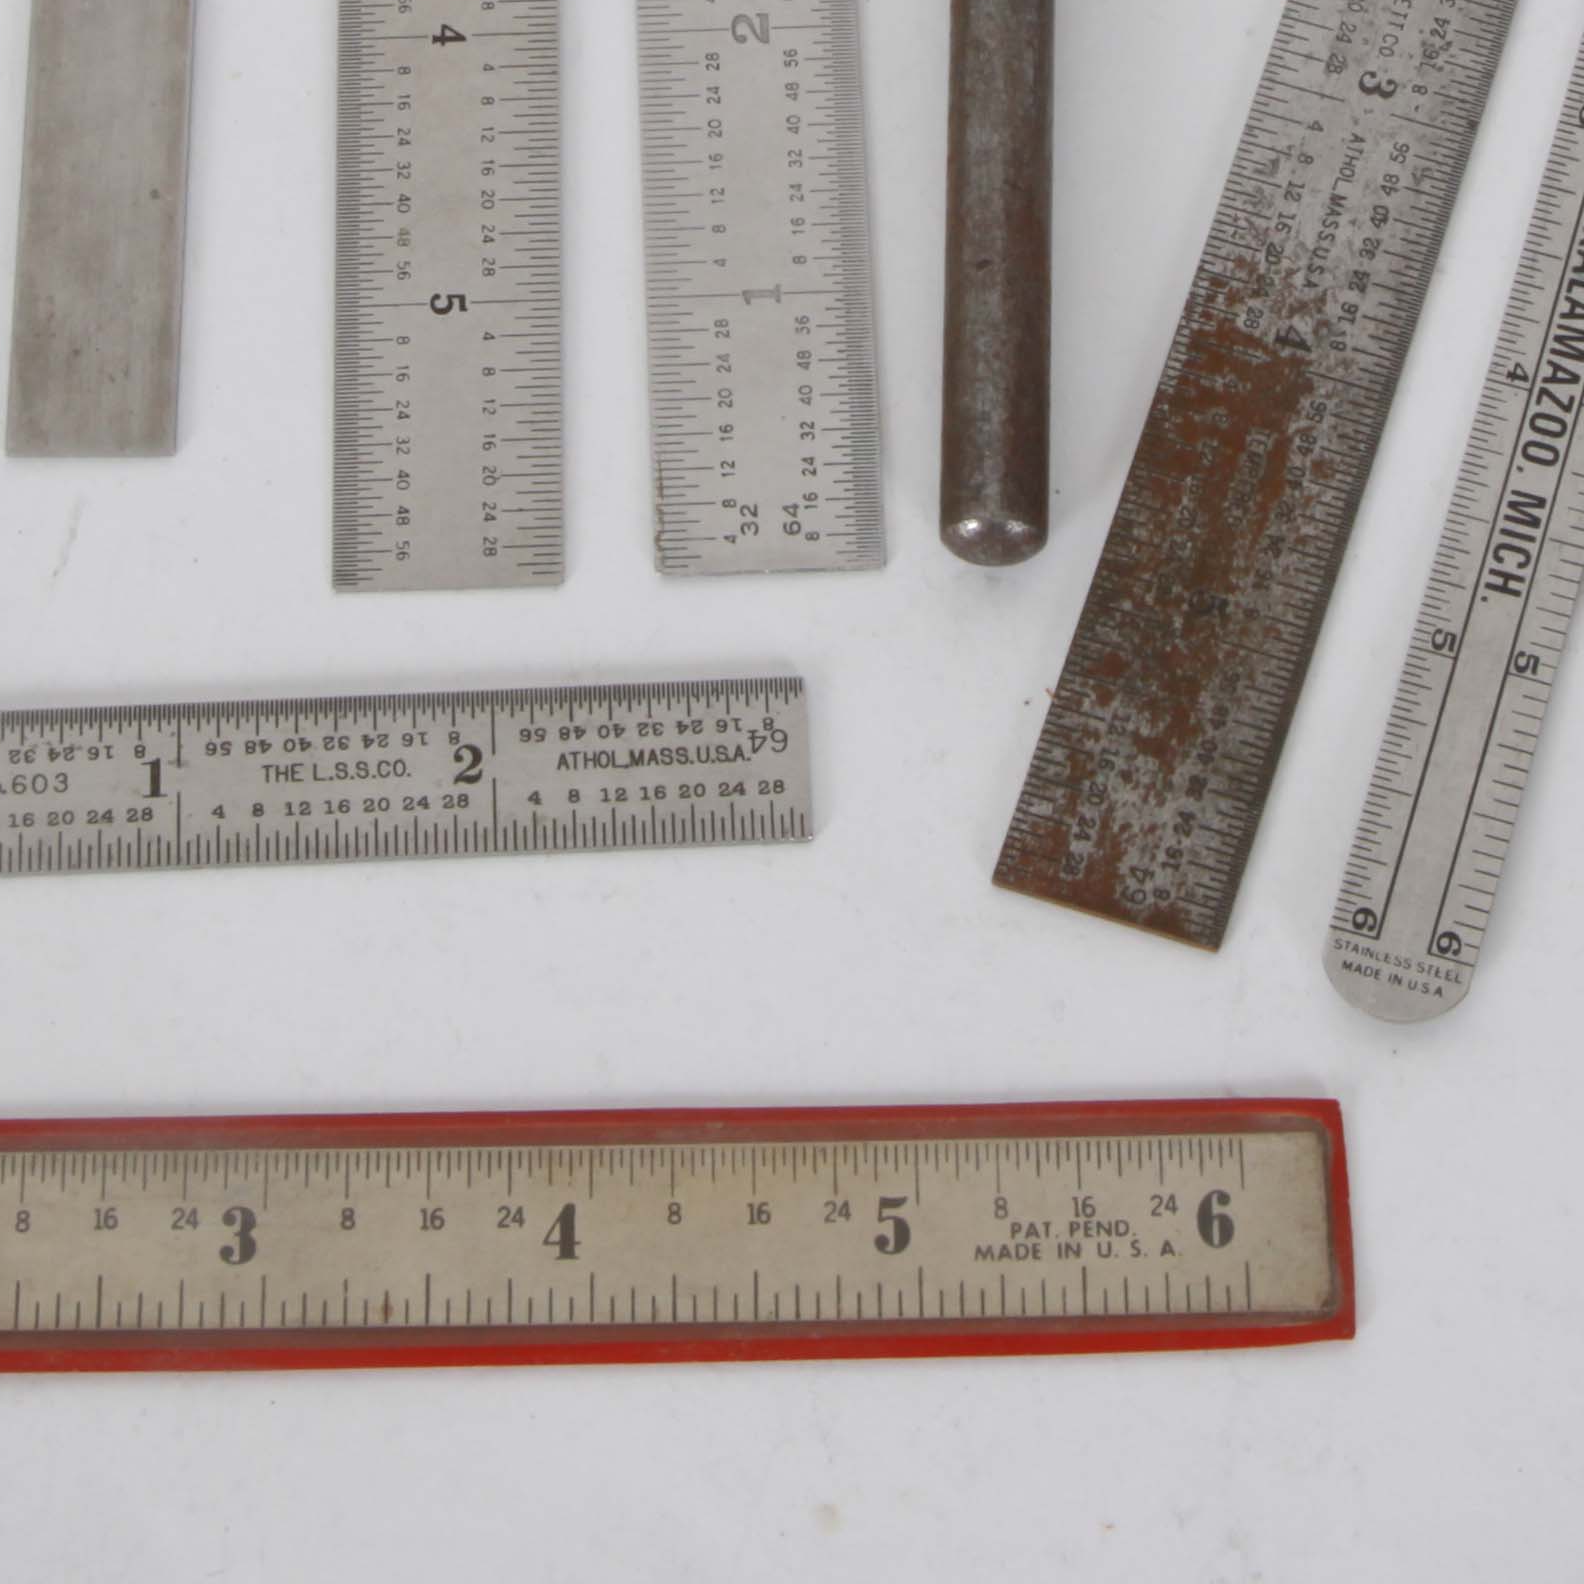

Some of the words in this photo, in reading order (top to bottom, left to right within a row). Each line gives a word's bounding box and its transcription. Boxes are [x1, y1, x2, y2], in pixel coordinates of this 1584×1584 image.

[432, 24, 467, 46] 4
[731, 13, 770, 44] 2
[1358, 71, 1399, 100] 3
[430, 293, 468, 315] 5
[1270, 325, 1319, 359] 4
[1506, 362, 1529, 383] 4
[739, 504, 759, 536] 32
[782, 503, 802, 536] 64
[1480, 490, 1547, 602] MICH.
[1431, 628, 1457, 653] 5
[1513, 651, 1540, 675] 5
[140, 756, 167, 798] 1
[261, 763, 304, 783] THE
[452, 743, 483, 784] 2
[8, 812, 35, 828] 16
[47, 810, 75, 827] 20
[87, 809, 114, 824] 24
[126, 807, 153, 823] 28
[211, 804, 226, 819] 4
[252, 803, 264, 817] 8
[285, 801, 312, 816] 12
[324, 799, 351, 815] 16
[363, 797, 390, 813] 20
[402, 796, 430, 811] 24
[442, 793, 469, 809] 28
[527, 790, 542, 805] 4
[568, 789, 580, 803] 8
[600, 787, 628, 803] 12
[640, 785, 667, 801] 16
[678, 783, 706, 799] 20
[718, 781, 746, 797] 24
[758, 779, 785, 795] 28
[1352, 907, 1377, 932] 6
[1334, 938, 1412, 970] STAINLESS
[1436, 931, 1462, 957] 6
[1342, 960, 1381, 980] MADE
[1388, 974, 1402, 986] IN
[15, 1210, 30, 1233] 8
[94, 1207, 118, 1230] 16
[171, 1207, 199, 1230] 24
[219, 1206, 257, 1265] 3
[340, 1207, 356, 1230] 8
[420, 1207, 445, 1231] 16
[497, 1205, 525, 1229] 24
[543, 1203, 581, 1260] 4
[667, 1202, 682, 1225] 8
[747, 1202, 771, 1225] 16
[824, 1200, 852, 1223] 24
[874, 1196, 911, 1255] 5
[994, 1197, 1008, 1219] 8
[1072, 1196, 1096, 1219] 16
[1150, 1194, 1178, 1217] 24
[1197, 1190, 1235, 1248] 6
[1010, 1221, 1058, 1240] PAT.
[1069, 1220, 1136, 1238] PEND.
[975, 1243, 1041, 1261] MADE
[1057, 1242, 1082, 1259] IN
